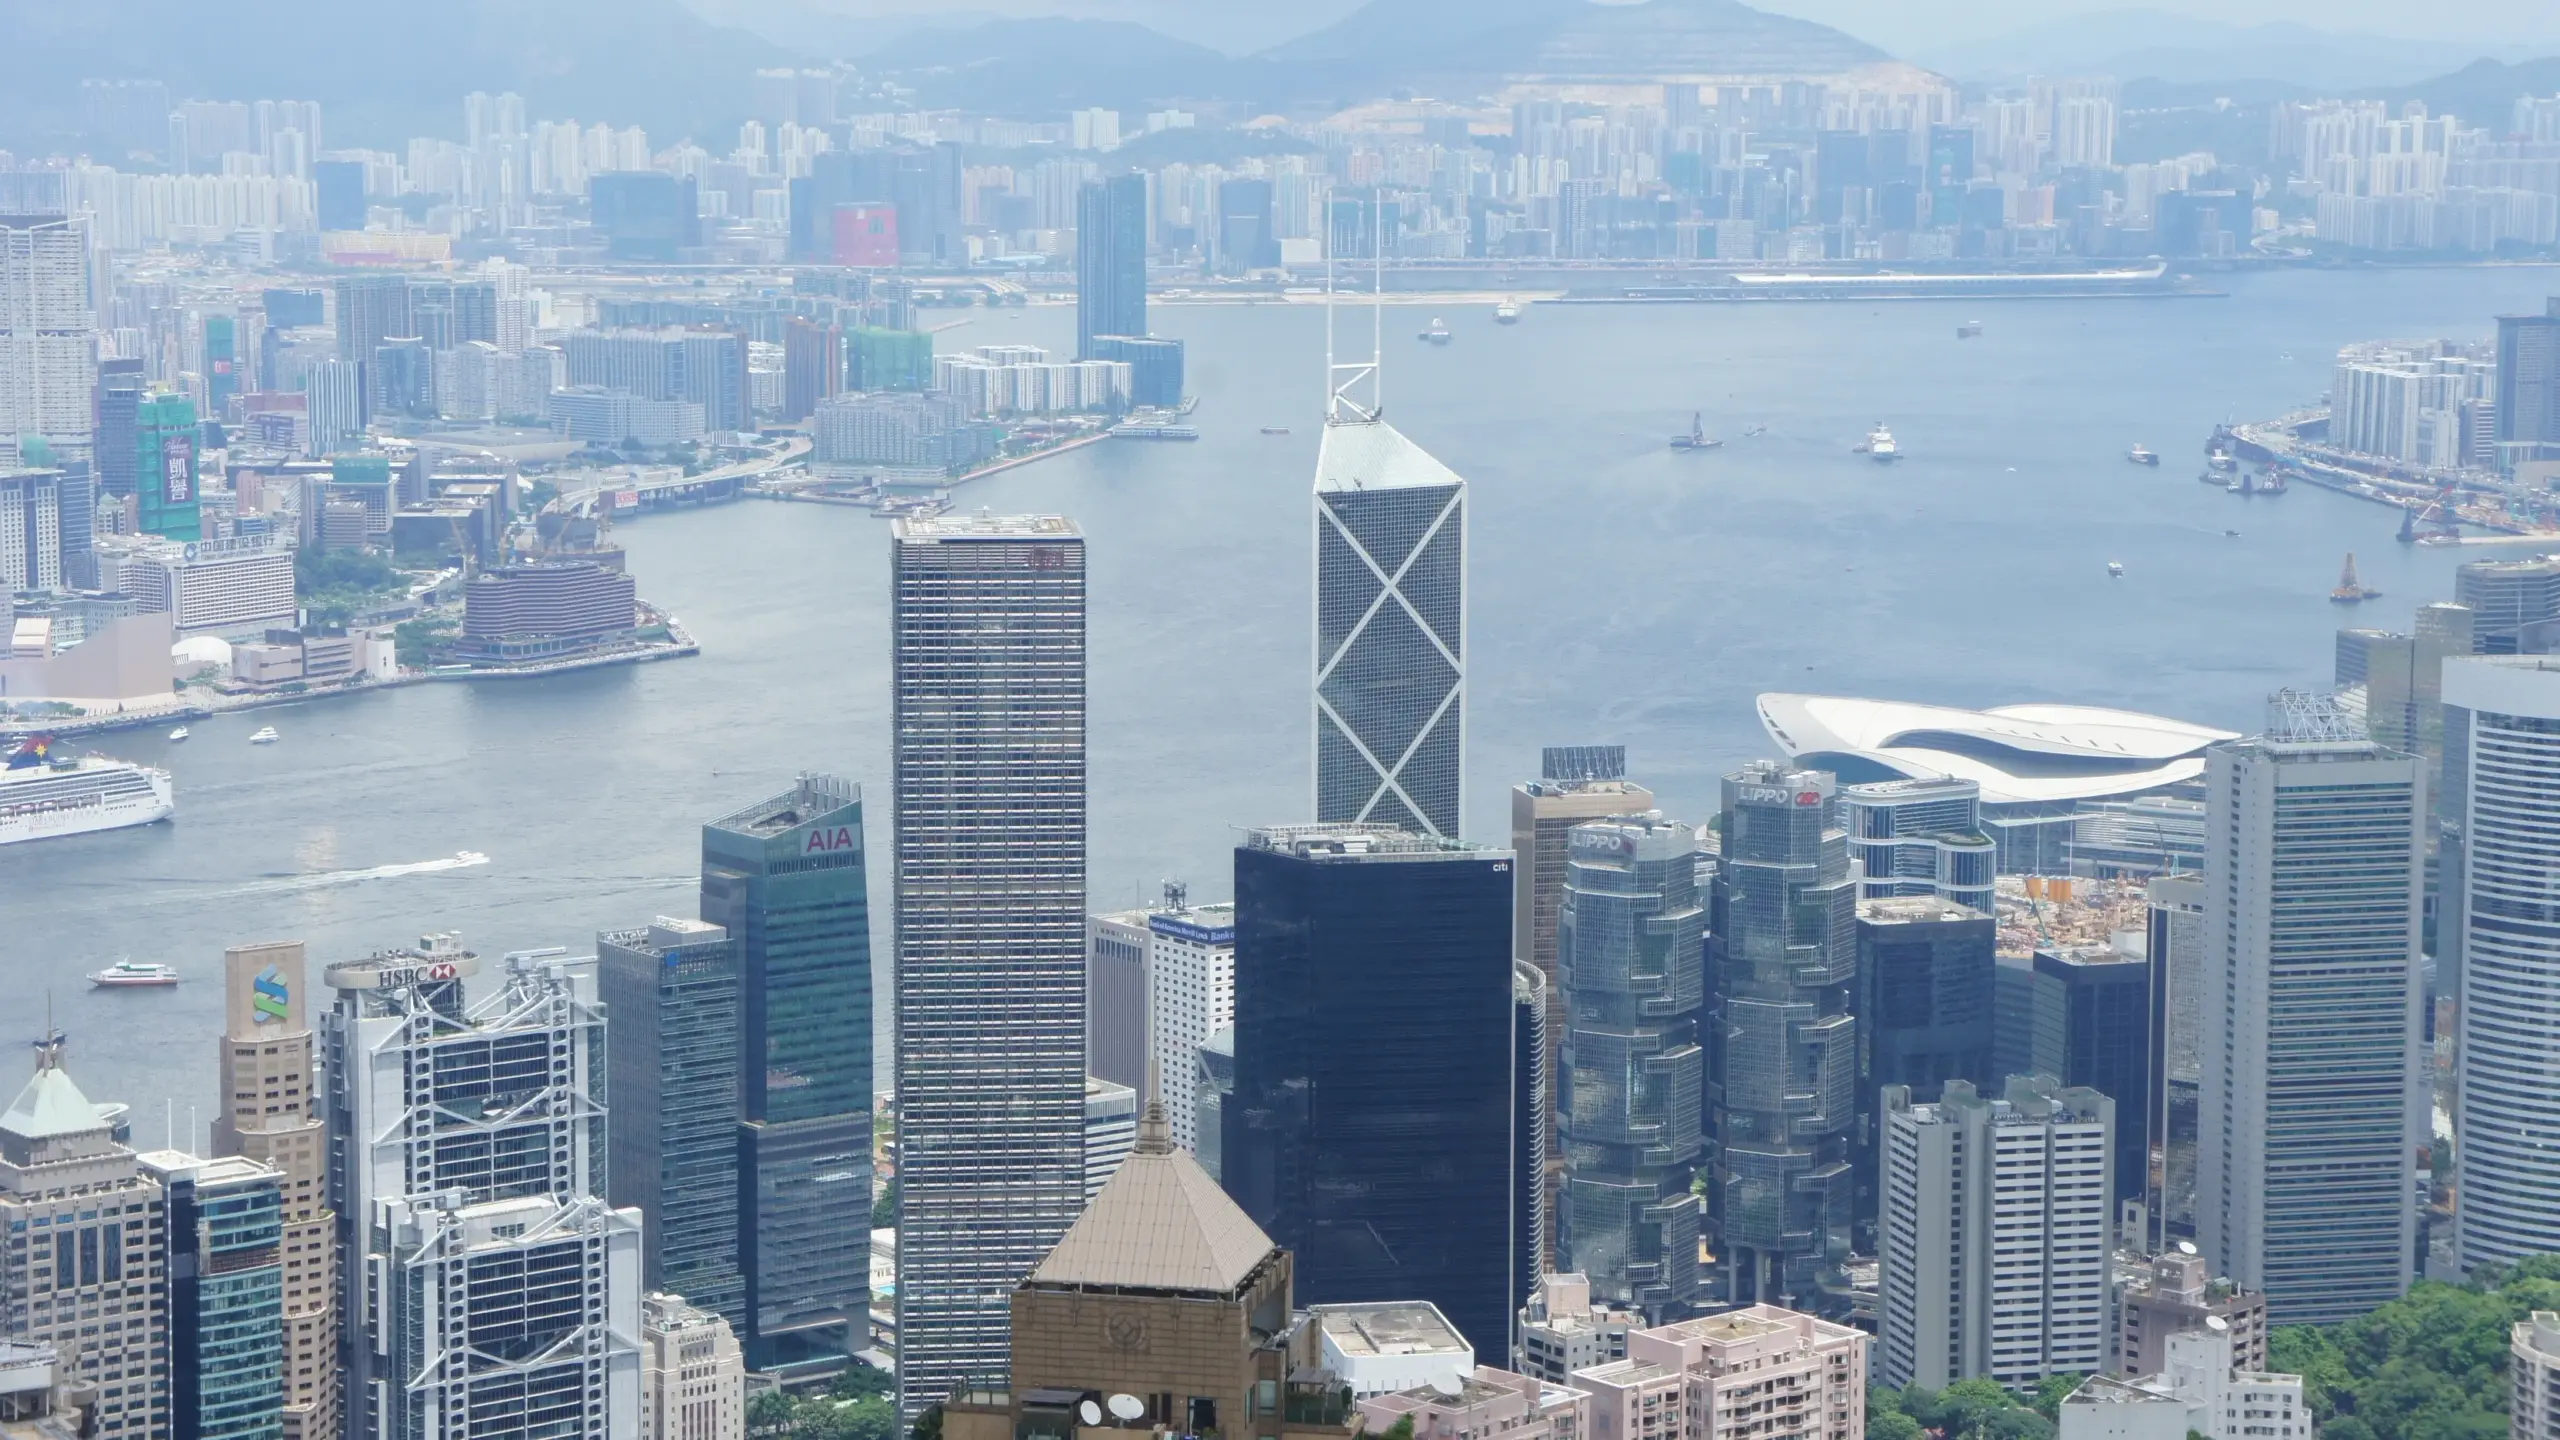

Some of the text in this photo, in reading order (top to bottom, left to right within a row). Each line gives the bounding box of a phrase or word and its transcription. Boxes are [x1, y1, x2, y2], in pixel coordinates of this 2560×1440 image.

[1739, 786, 1788, 804] LIPPO
[806, 828, 853, 852] AIA
[1571, 832, 1620, 850] LIPPO
[1493, 862, 1508, 872] citi
[1211, 931, 1229, 941] Bank
[379, 966, 428, 987] HSBC
